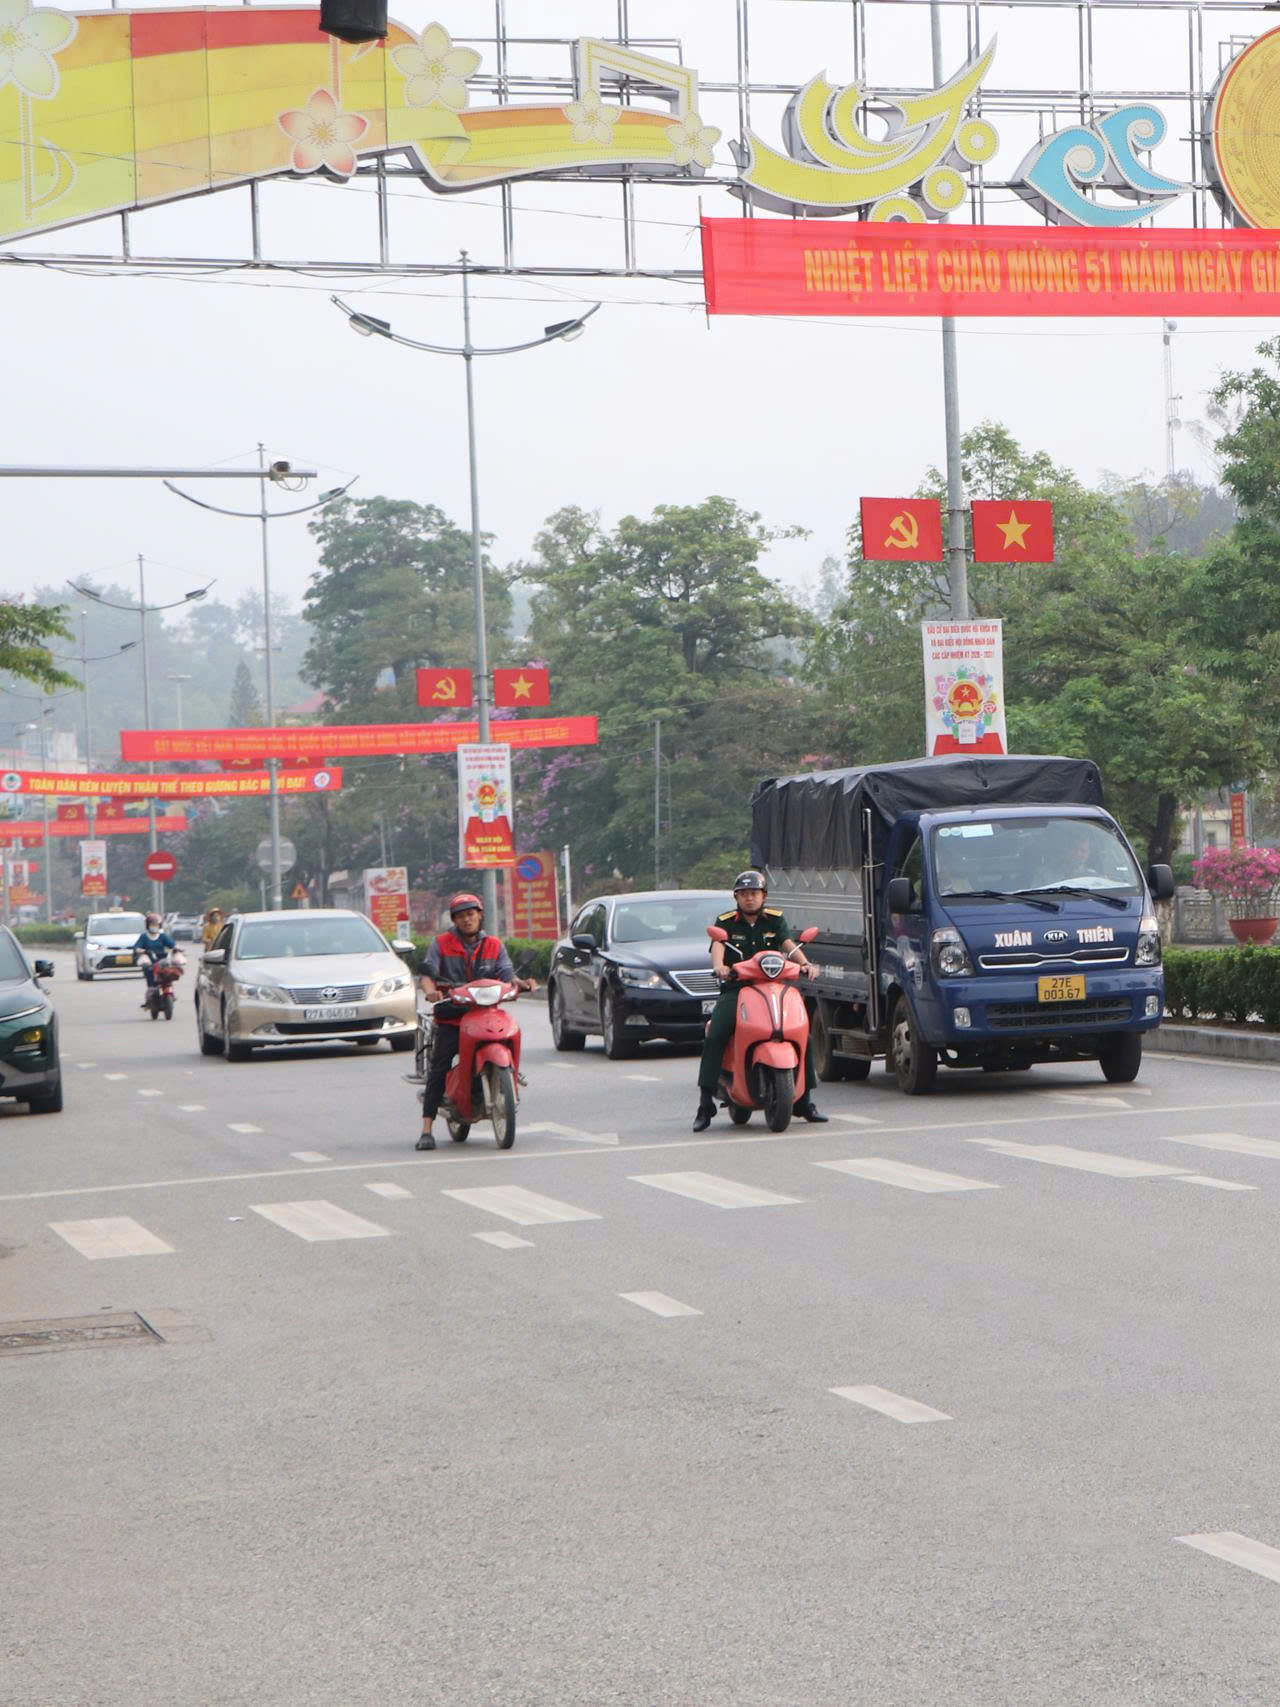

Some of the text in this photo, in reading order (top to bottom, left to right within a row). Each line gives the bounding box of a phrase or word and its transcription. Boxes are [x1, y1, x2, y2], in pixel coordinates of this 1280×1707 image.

[803, 239, 873, 303] NHIỆT
[880, 239, 930, 303] LIỆT
[936, 240, 1001, 294] CHÀO
[1085, 249, 1112, 294] 51
[1120, 240, 1177, 294] NĂM
[1182, 240, 1243, 294] NGÀY
[994, 925, 1114, 948] XUÂN THIÊN
[1052, 977, 1071, 989] 27E
[1043, 988, 1080, 1000] 003.67
